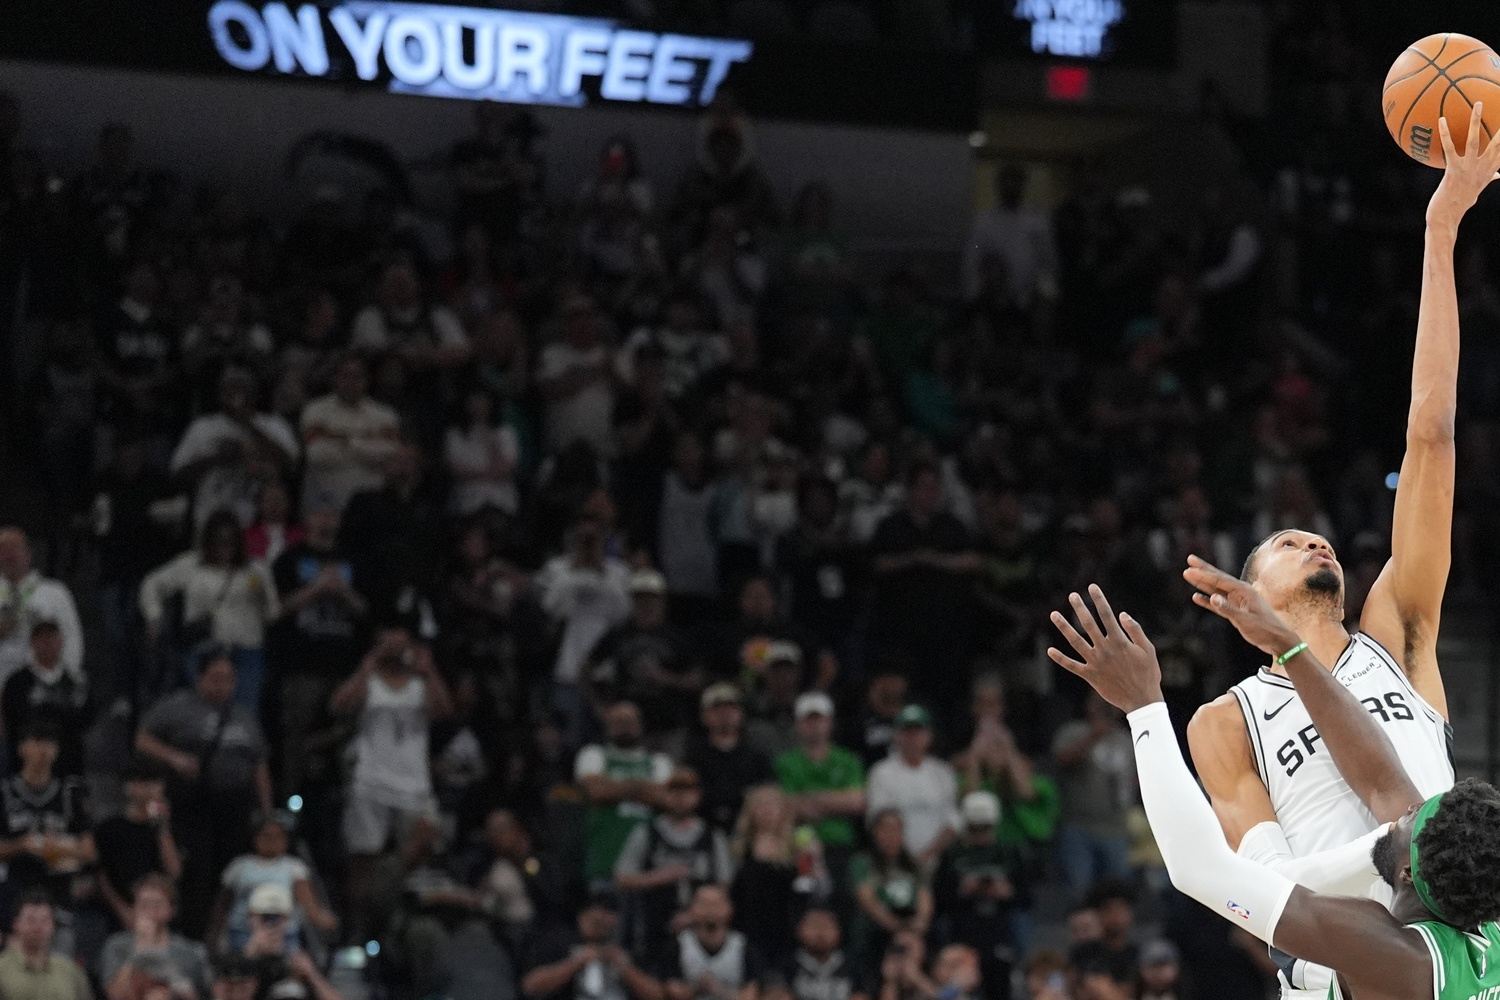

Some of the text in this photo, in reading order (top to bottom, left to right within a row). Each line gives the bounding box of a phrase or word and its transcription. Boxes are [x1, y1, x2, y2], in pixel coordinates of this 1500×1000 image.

[208, 0, 753, 107] ON YOUR FEET
[1347, 662, 1376, 682] LEDGER
[1276, 691, 1414, 778] SPRS
